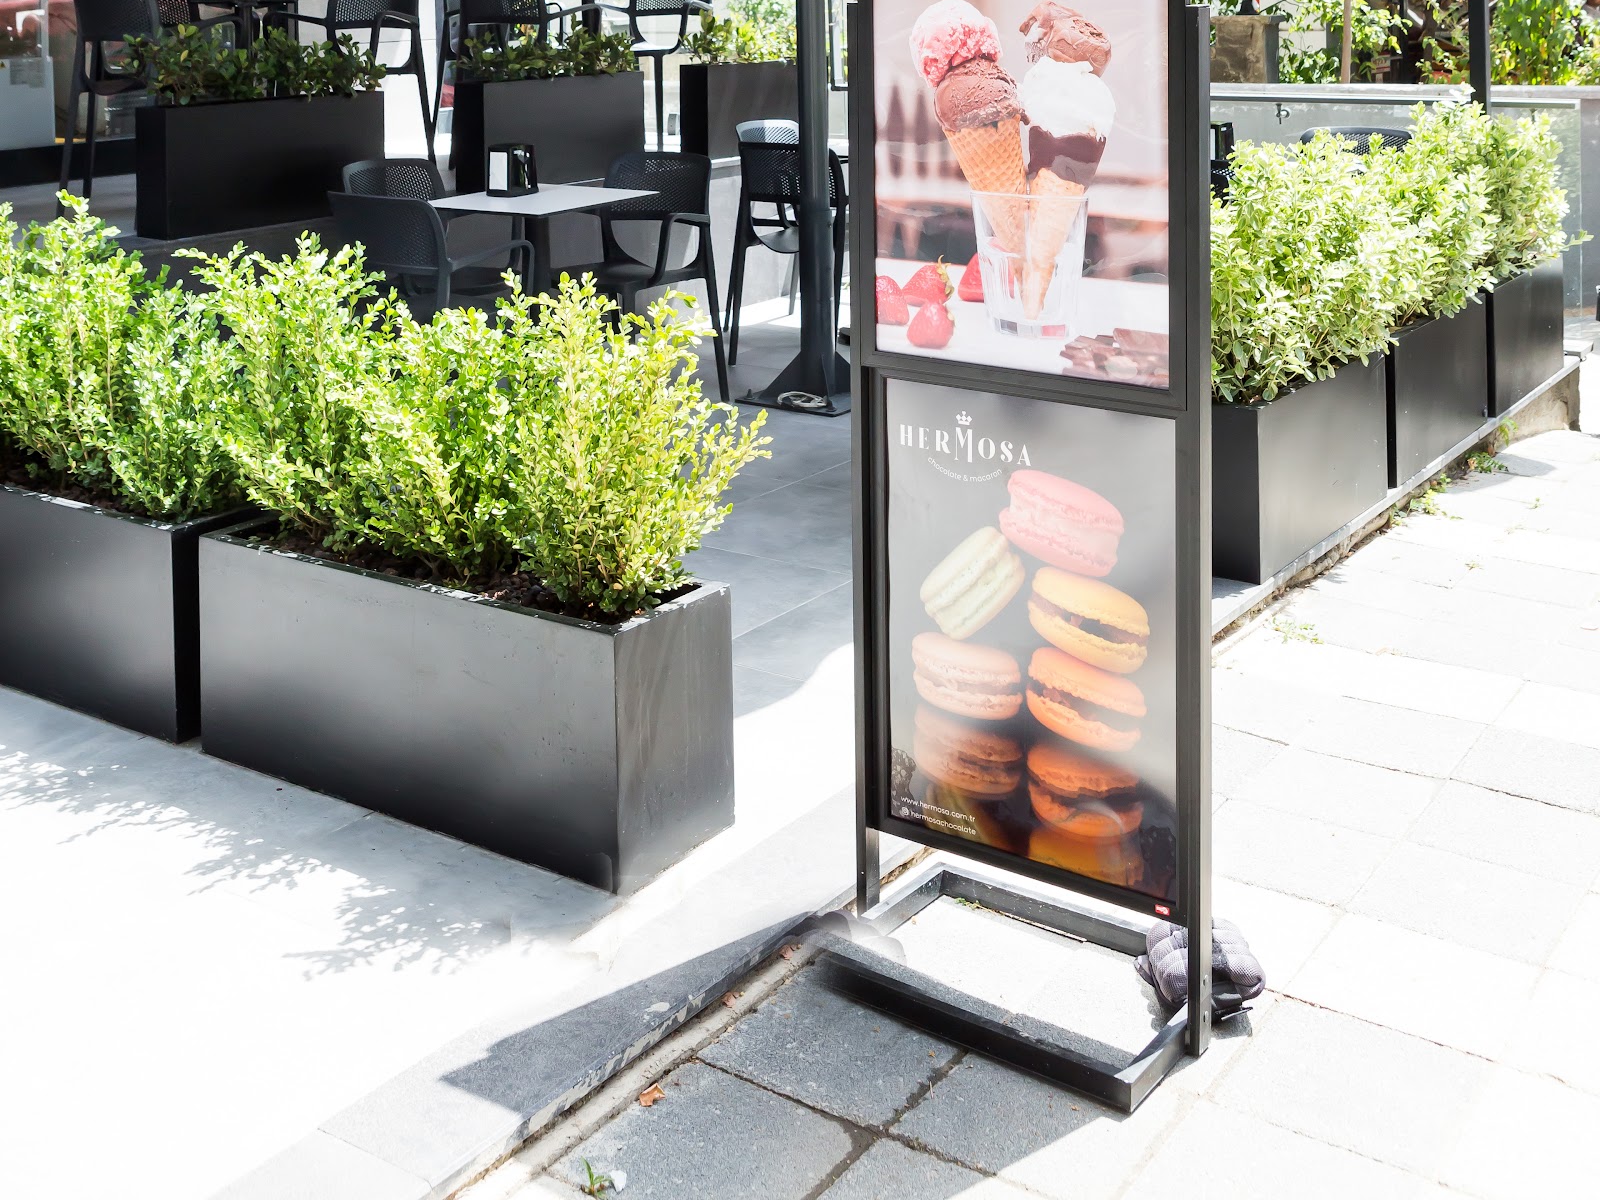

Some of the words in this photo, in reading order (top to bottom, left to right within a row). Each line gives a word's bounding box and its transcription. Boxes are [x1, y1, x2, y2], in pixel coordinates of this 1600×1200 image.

[899, 423, 1032, 467] HERMOSA
[927, 456, 962, 481] chocolate
[963, 473, 969, 482] &
[969, 468, 1003, 483] macaron
[900, 796, 976, 823] www.hermosa.com.tr
[910, 810, 977, 836] hermosachocolate
